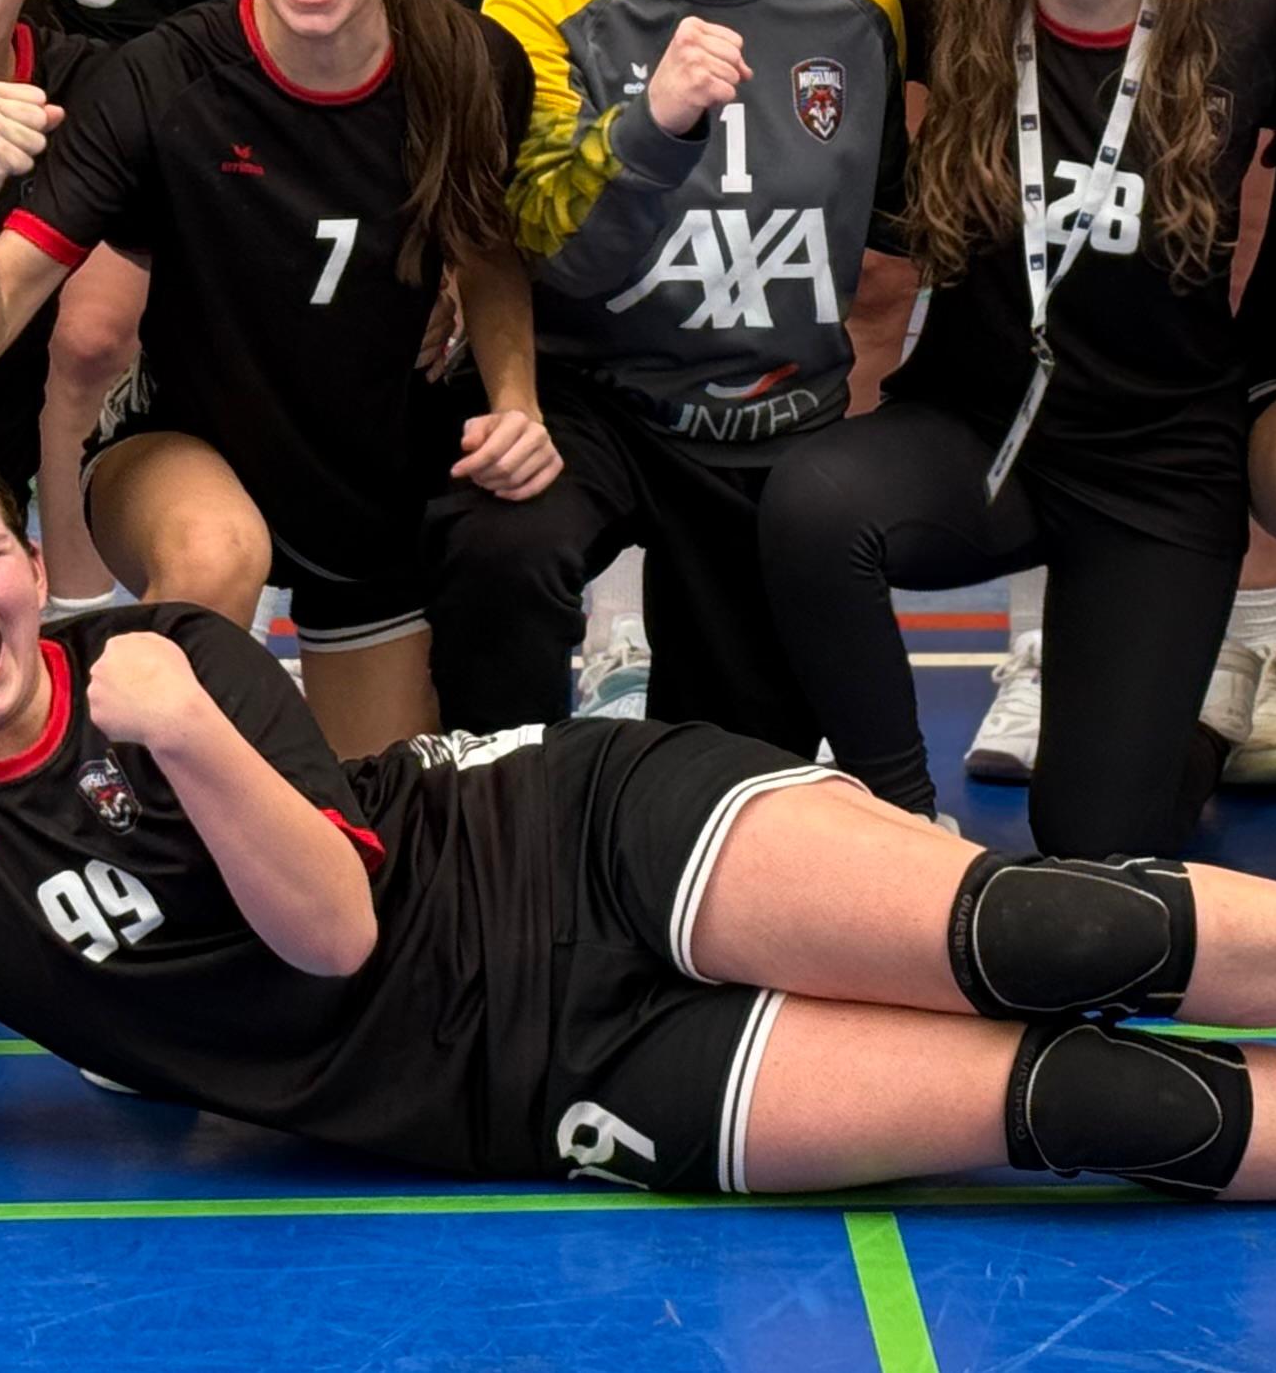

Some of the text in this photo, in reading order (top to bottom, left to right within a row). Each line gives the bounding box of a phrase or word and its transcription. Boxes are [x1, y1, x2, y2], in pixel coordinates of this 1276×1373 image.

[719, 103, 753, 193] 1
[1046, 159, 1145, 255] 28
[309, 218, 360, 305] 7
[605, 207, 841, 329] AXA
[37, 859, 165, 963] 99
